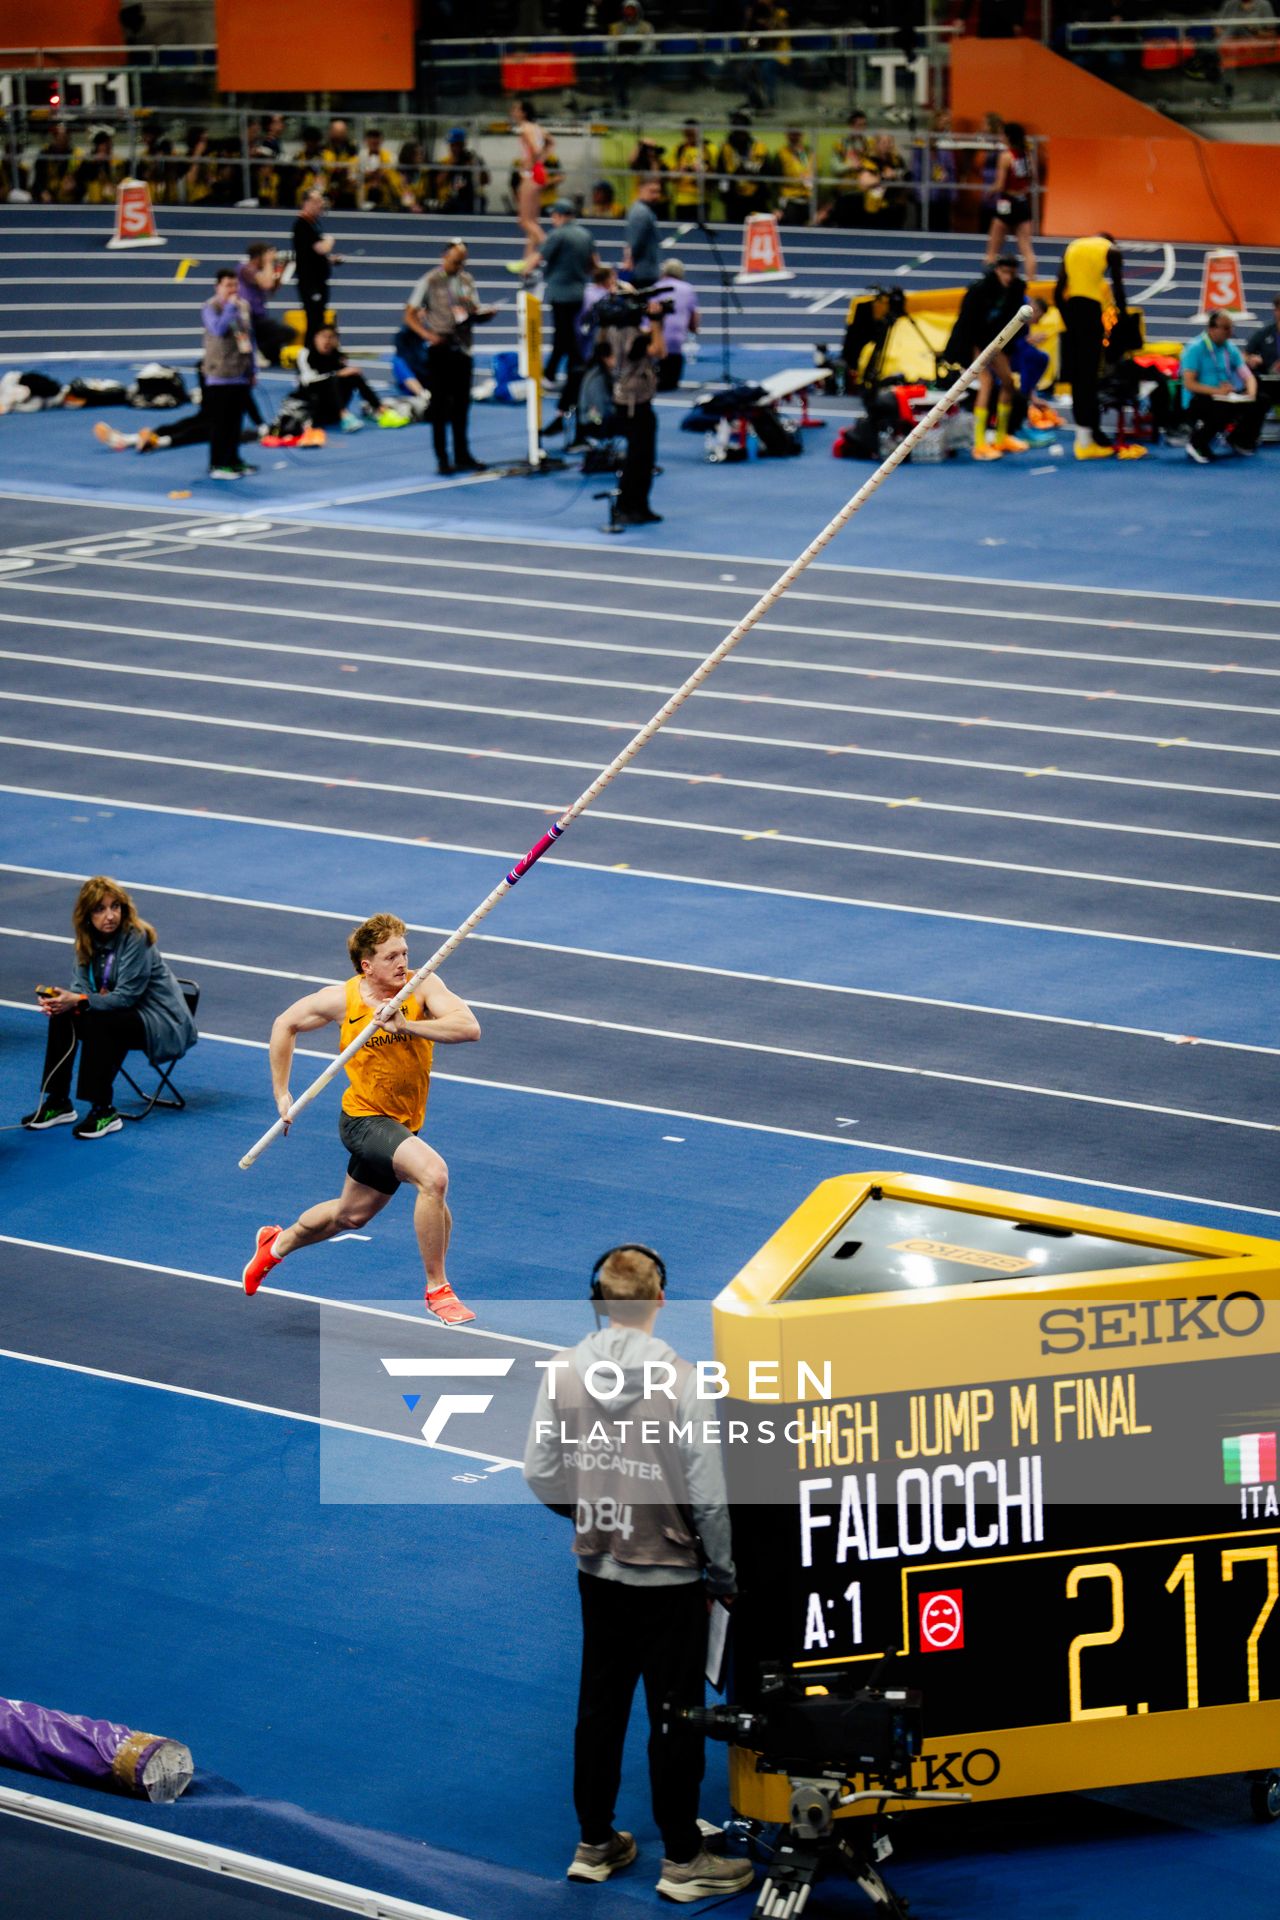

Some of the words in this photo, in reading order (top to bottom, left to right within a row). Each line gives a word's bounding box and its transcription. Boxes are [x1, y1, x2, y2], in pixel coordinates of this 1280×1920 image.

[67, 74, 130, 112] T1
[869, 55, 928, 105] T1
[750, 234, 774, 265] 4
[1209, 272, 1237, 306] 3
[361, 1032, 414, 1048] ERMANY
[1039, 1290, 1265, 1356] SEIKO
[797, 1400, 879, 1470] HIGH
[895, 1388, 994, 1460] JUMP
[1010, 1383, 1039, 1448] M
[1053, 1373, 1153, 1444] FINAL
[799, 1455, 1044, 1567] FALOCCHI
[1241, 1485, 1280, 1519] ITA
[1066, 1545, 1279, 1722] 2.17
